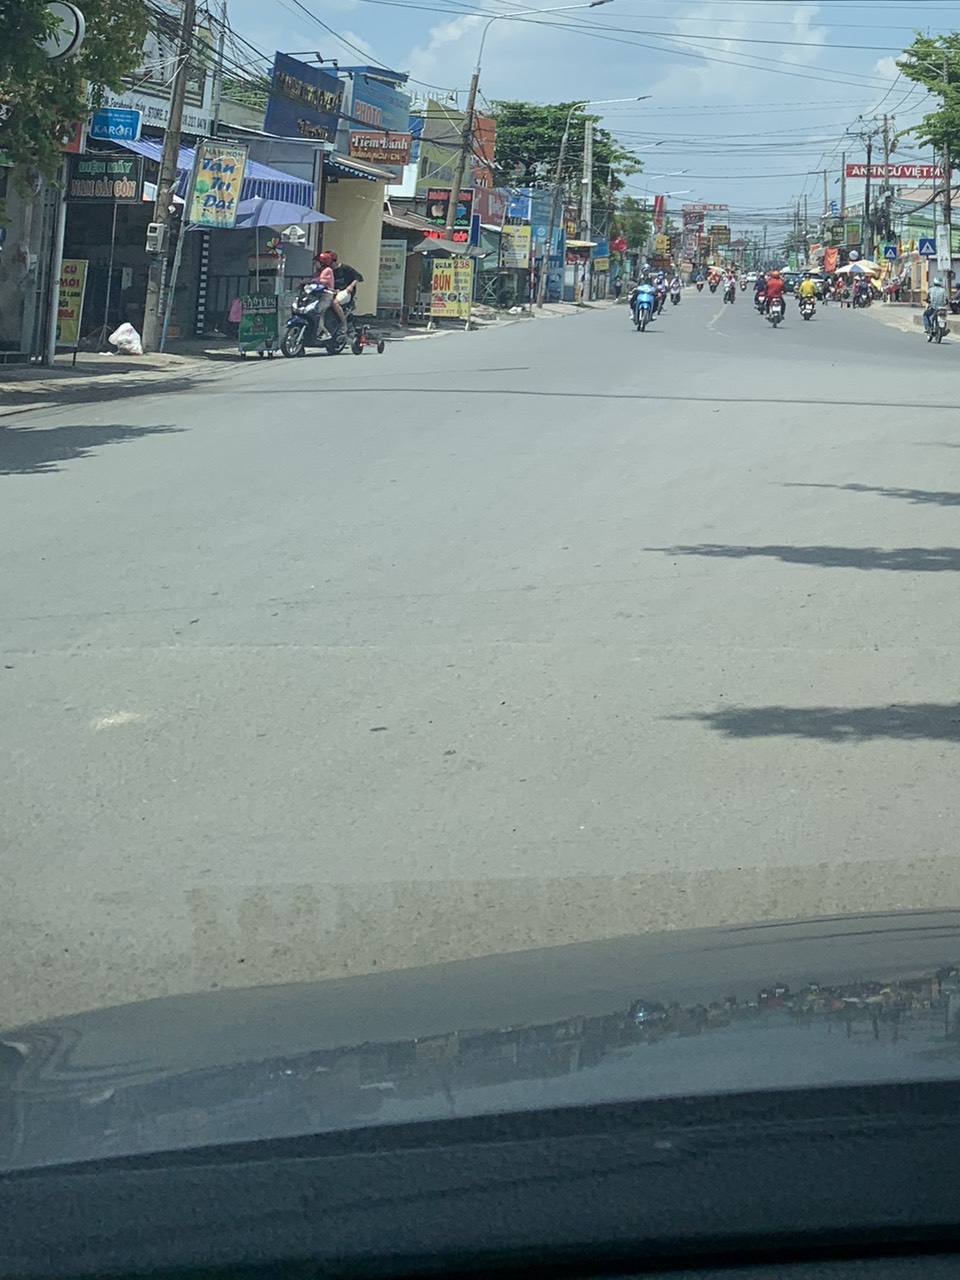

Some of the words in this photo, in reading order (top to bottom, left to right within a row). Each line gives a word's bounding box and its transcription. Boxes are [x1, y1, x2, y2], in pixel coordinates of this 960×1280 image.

[93, 124, 133, 136] KAROFI
[904, 165, 928, 178] VIỆT
[71, 179, 95, 197] NAM
[453, 260, 471, 270] 238
[433, 270, 452, 291] BÚN
